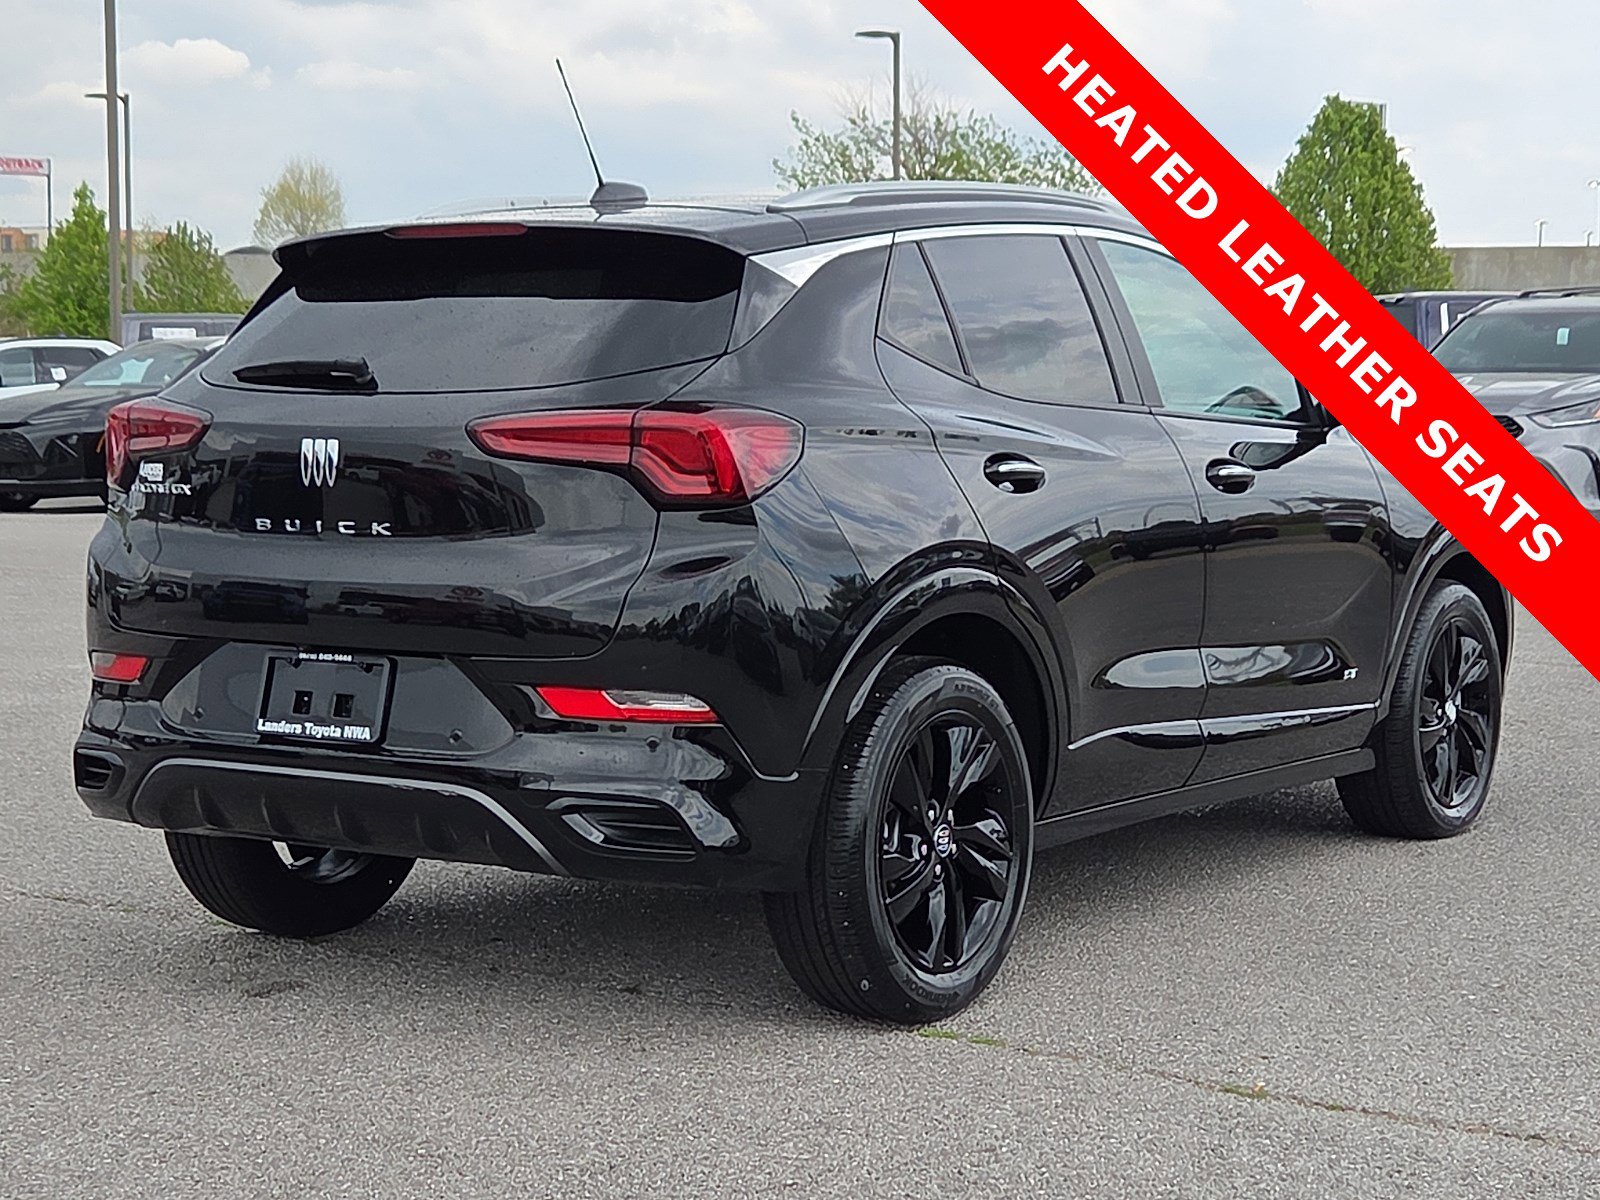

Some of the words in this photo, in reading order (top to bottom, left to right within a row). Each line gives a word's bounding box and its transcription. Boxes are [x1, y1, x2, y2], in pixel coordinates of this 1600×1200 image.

[254, 517, 393, 537] BUICK
[256, 718, 303, 735] Landers
[303, 722, 342, 739] Toyota
[343, 725, 372, 741] NWA
